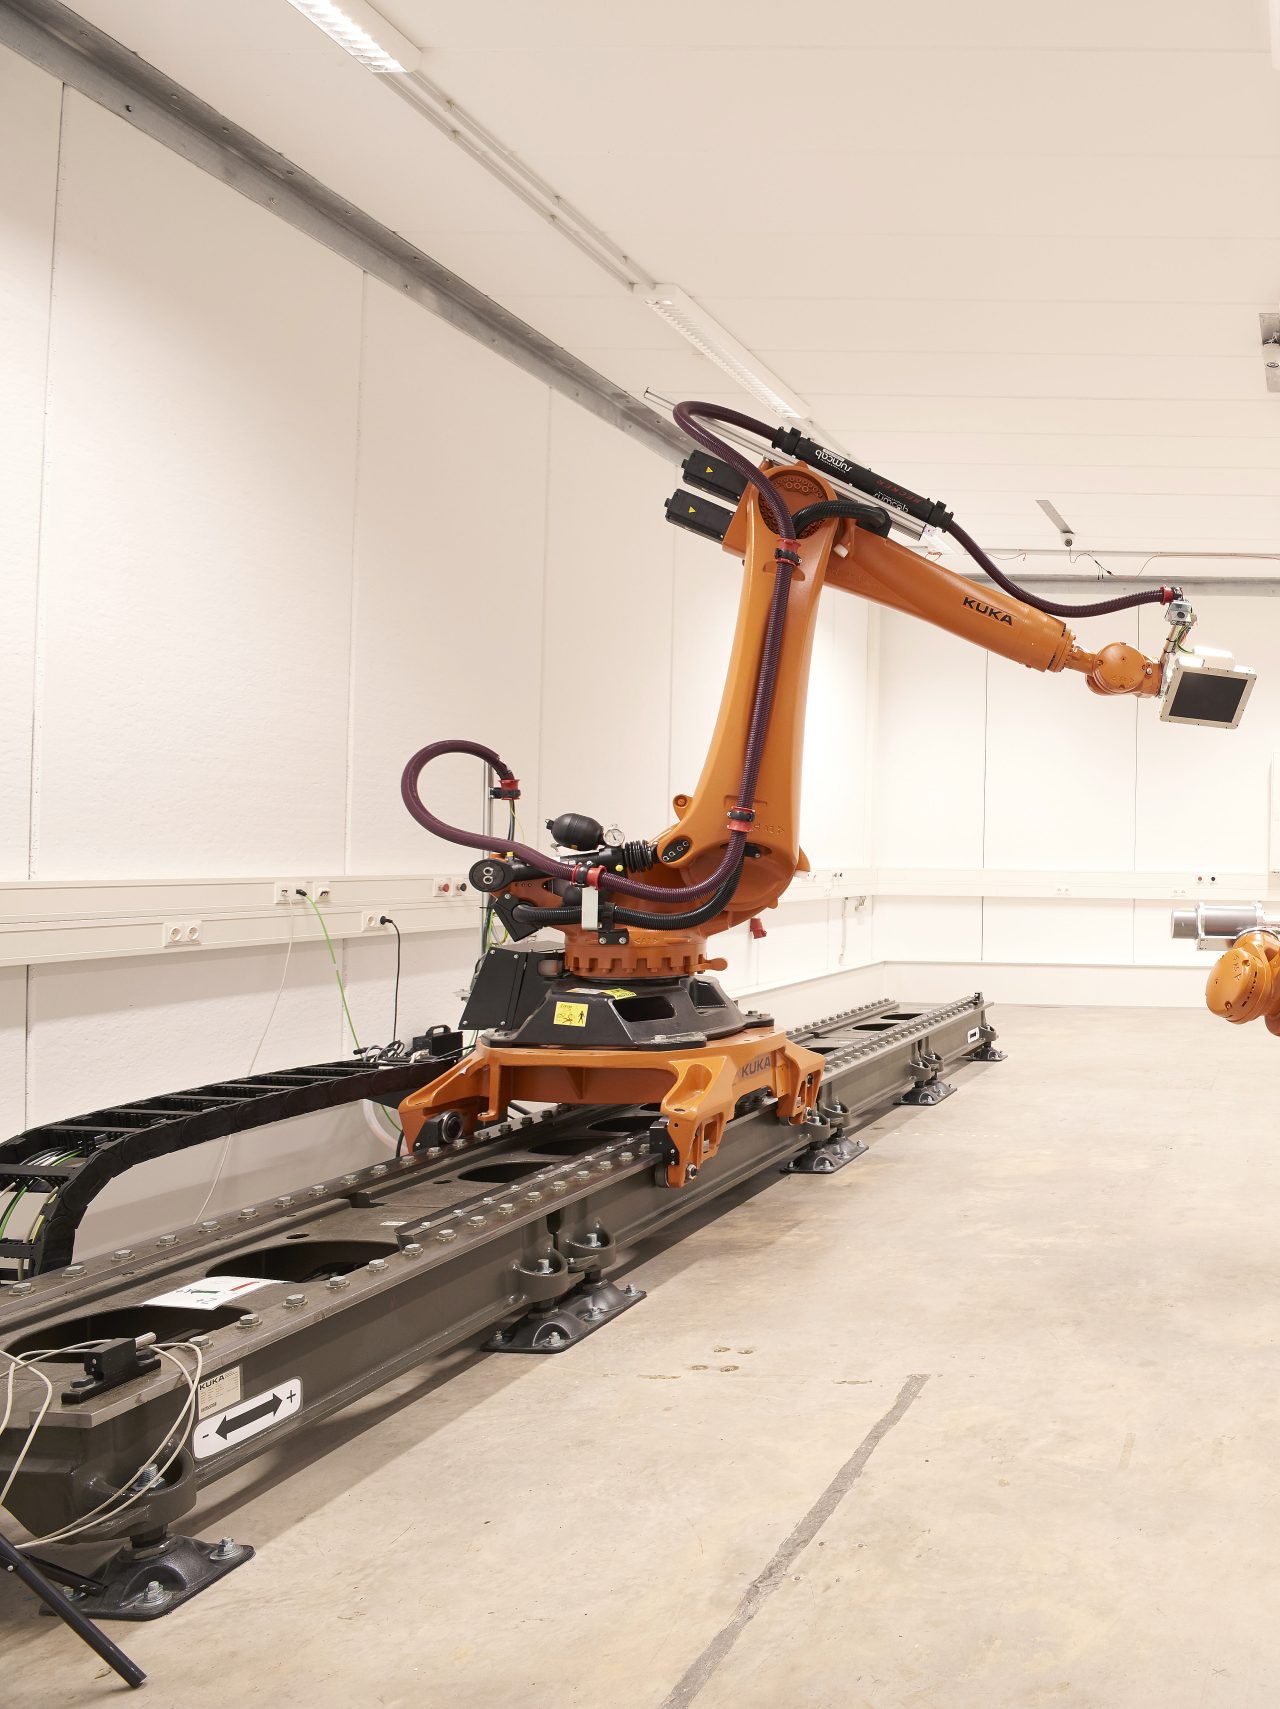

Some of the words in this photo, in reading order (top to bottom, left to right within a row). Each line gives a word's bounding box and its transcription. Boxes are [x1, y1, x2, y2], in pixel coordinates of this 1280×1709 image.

[815, 449, 853, 473] sumcab
[963, 597, 1012, 626] KUKA
[742, 1056, 771, 1078] KUKA
[199, 1374, 225, 1391] KUKA
